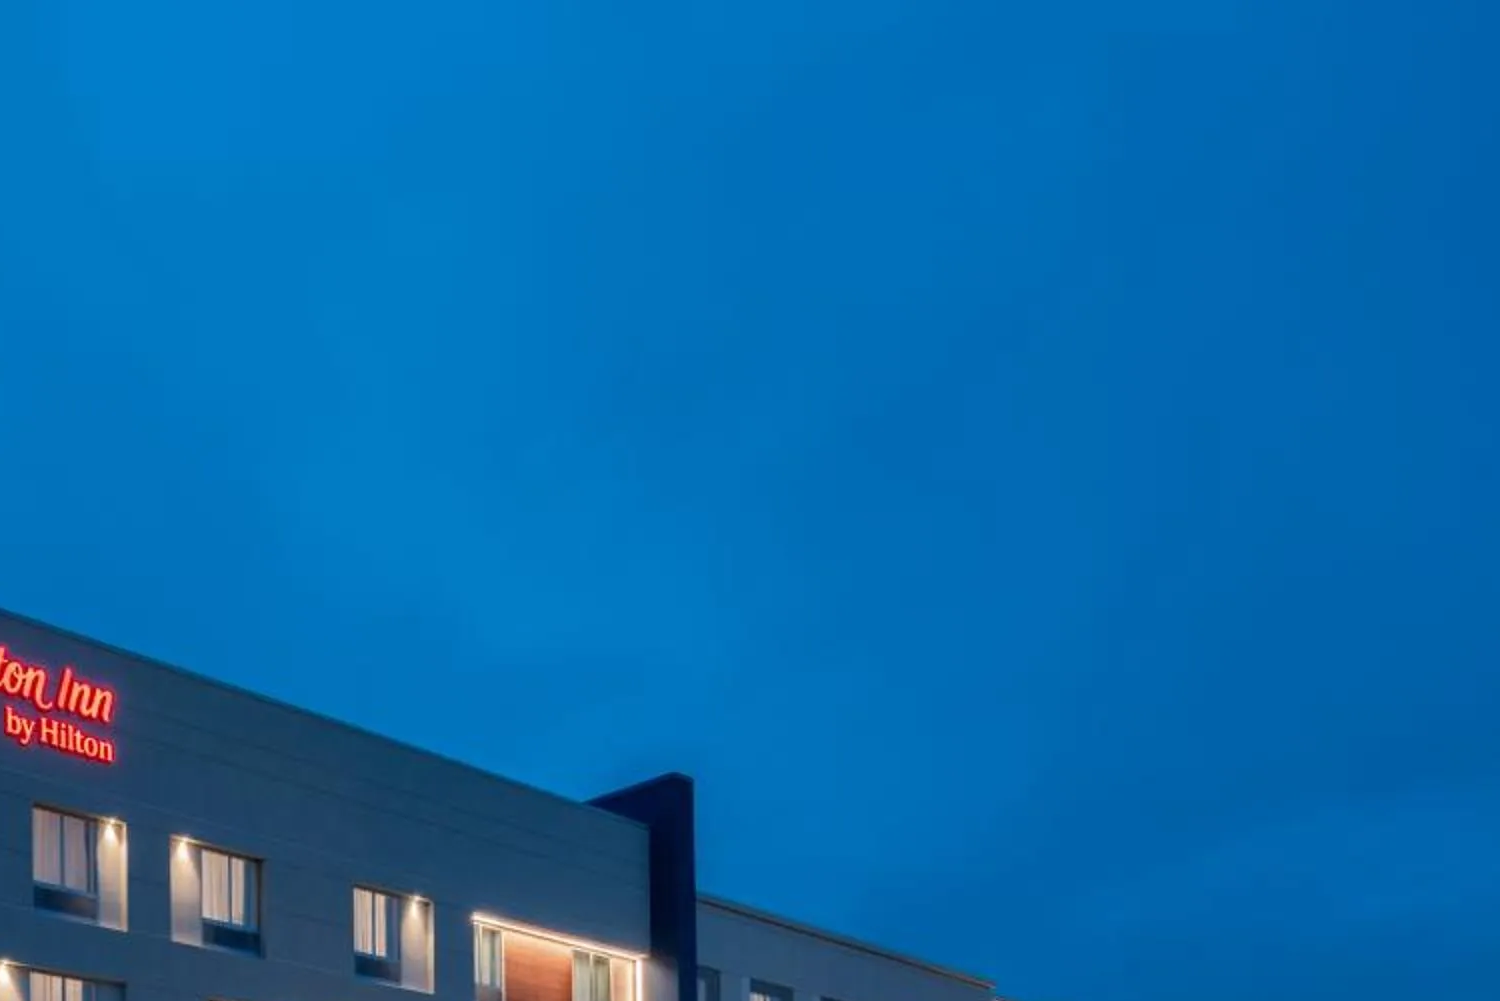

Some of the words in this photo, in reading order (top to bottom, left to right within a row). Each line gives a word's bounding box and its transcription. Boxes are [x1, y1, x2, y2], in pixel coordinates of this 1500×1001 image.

[57, 667, 114, 722] Inn
[5, 706, 36, 745] by
[40, 716, 114, 762] Hilton
